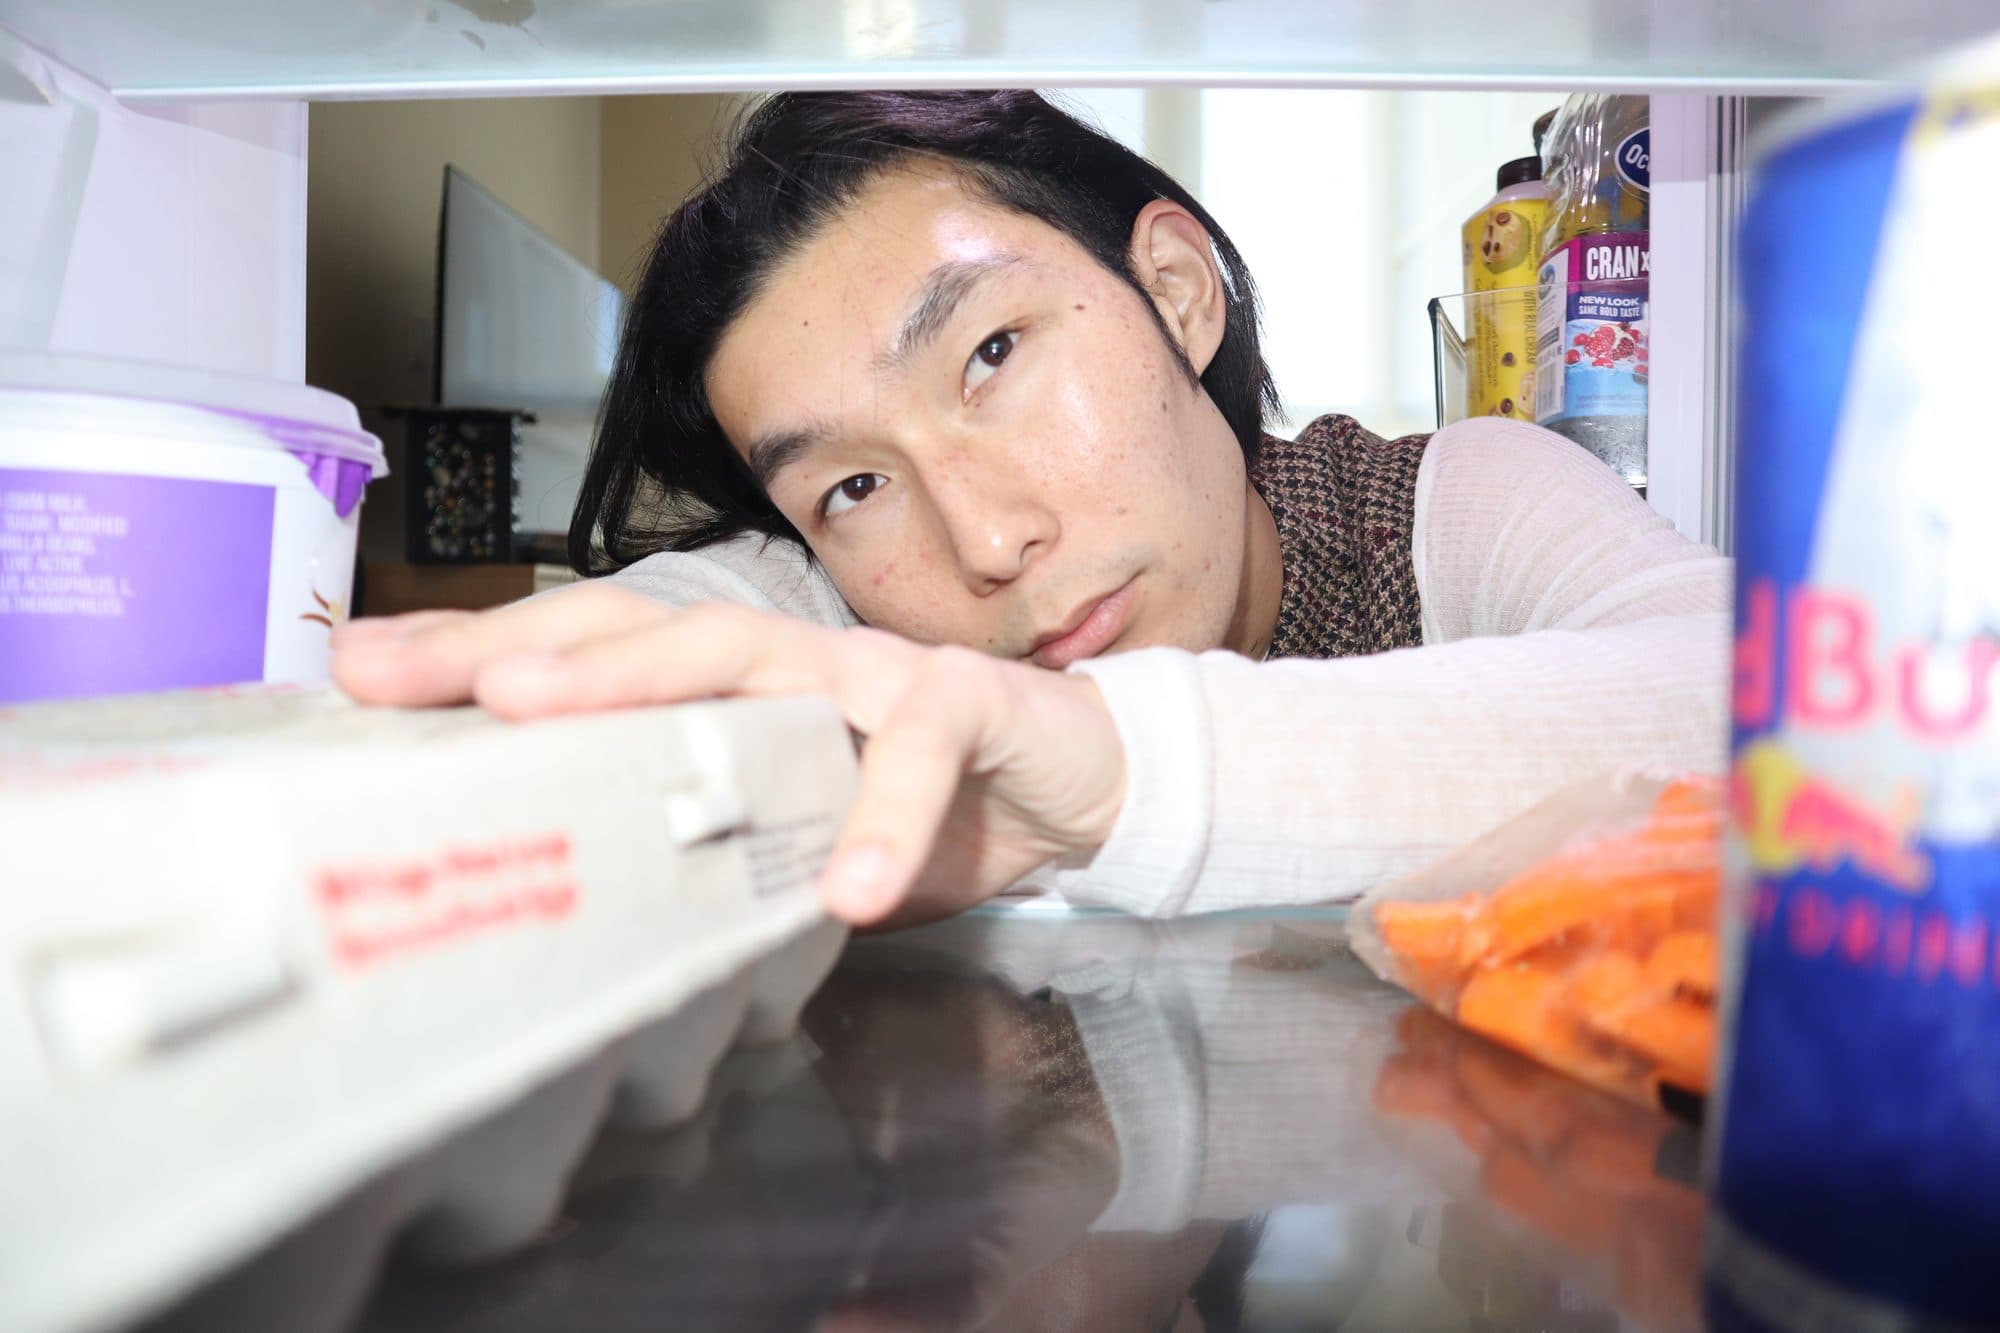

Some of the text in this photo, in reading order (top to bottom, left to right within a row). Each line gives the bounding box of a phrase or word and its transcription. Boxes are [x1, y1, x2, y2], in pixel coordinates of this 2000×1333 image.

[1625, 143, 1649, 173] Oc
[1579, 295, 1639, 307] NEW LOOK
[1578, 305, 1641, 318] SAME BOLD TASTE
